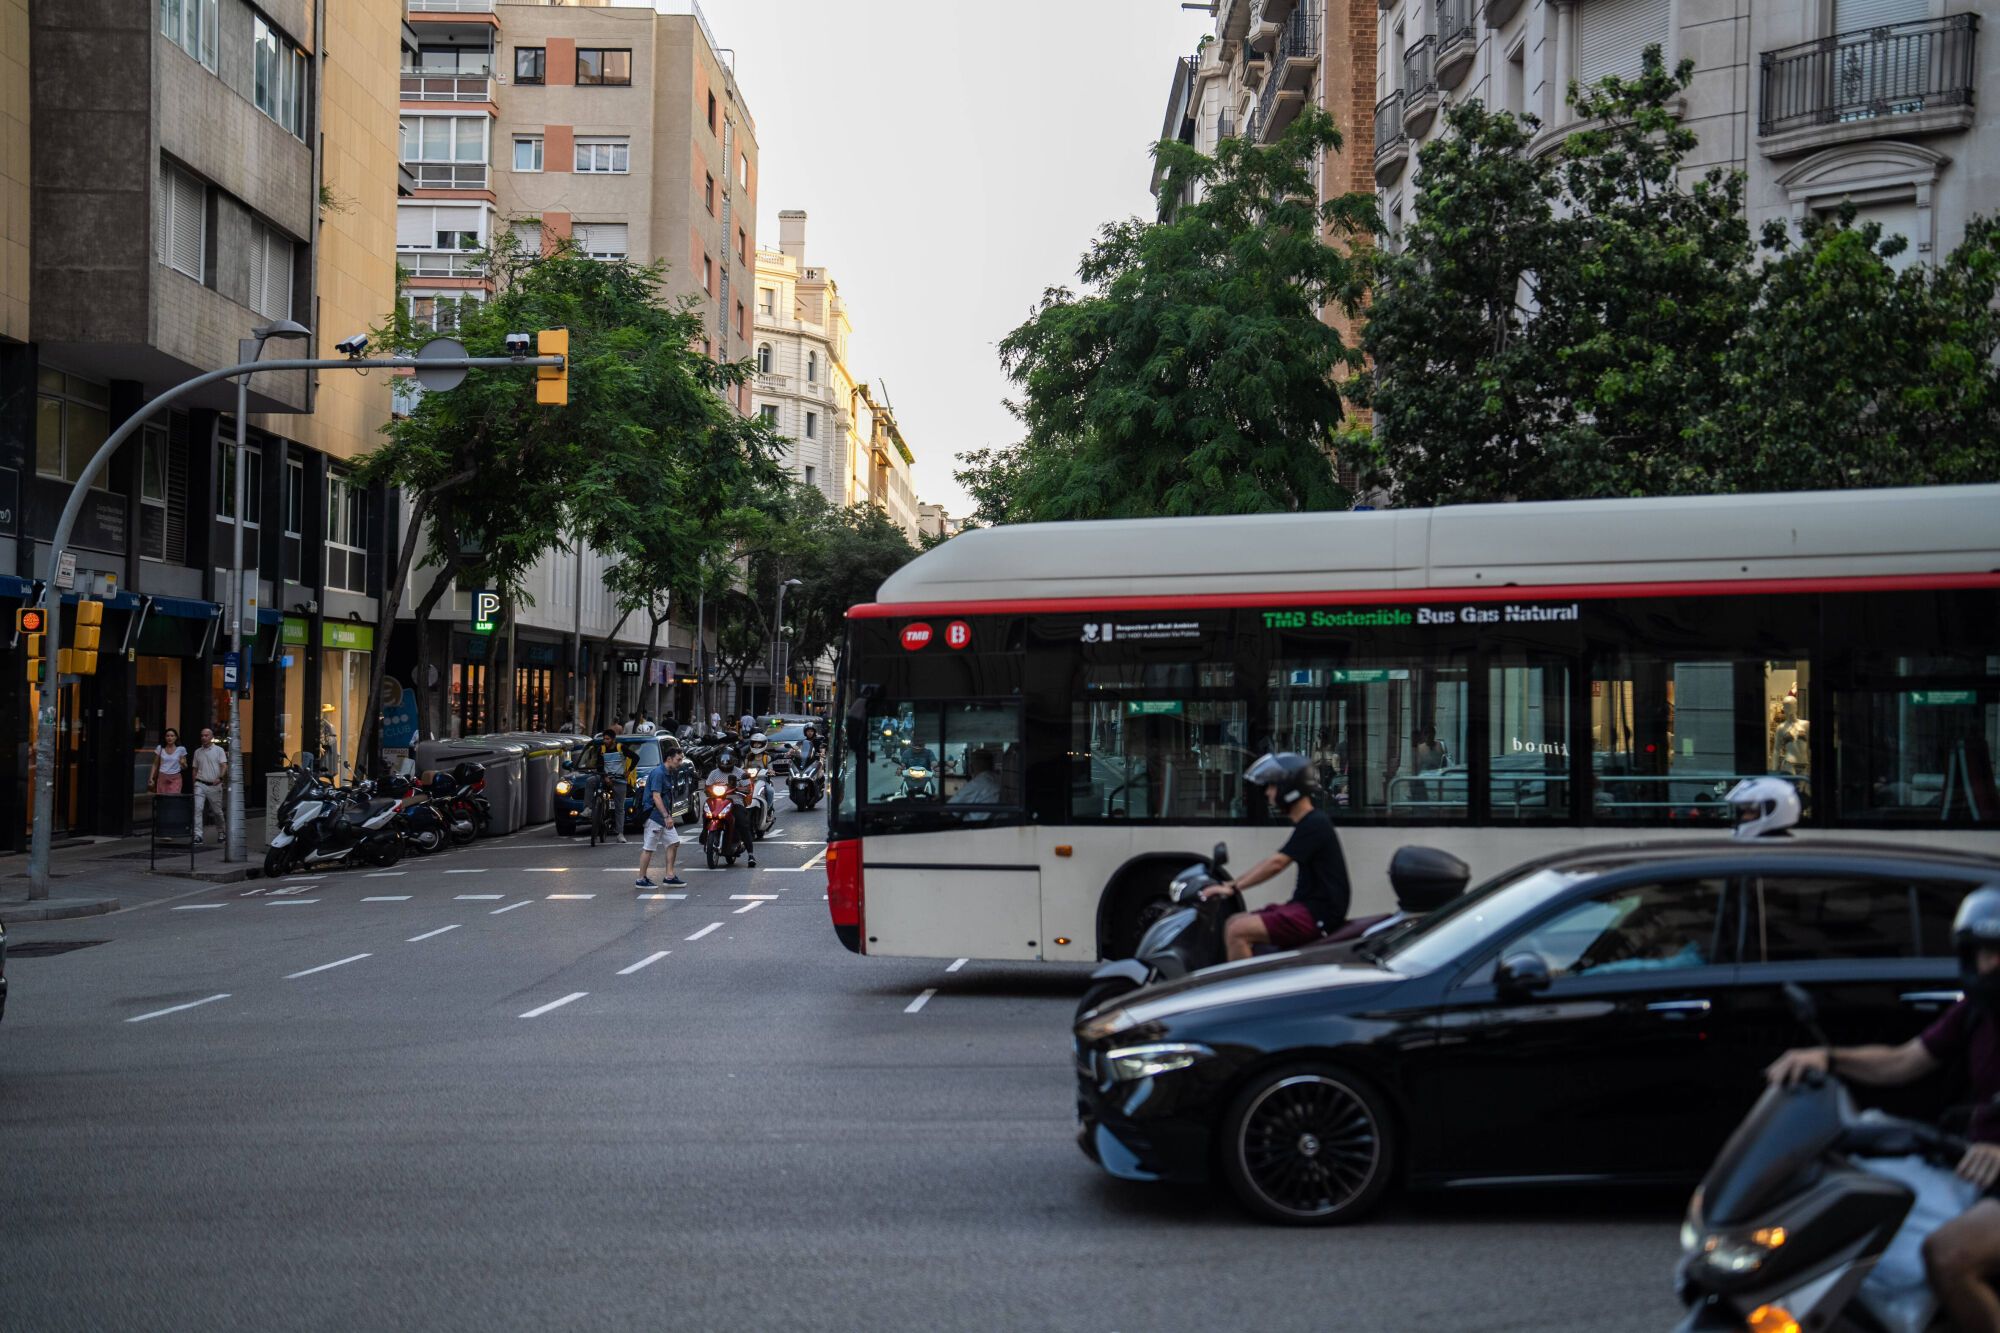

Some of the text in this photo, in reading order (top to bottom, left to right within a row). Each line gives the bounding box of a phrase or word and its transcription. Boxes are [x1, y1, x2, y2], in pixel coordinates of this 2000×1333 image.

[478, 593, 500, 621] P
[1262, 603, 1579, 629] TMB Sostenible Bus Gas Natural
[906, 630, 929, 641] TMB
[952, 625, 965, 644] B
[624, 661, 638, 672] m
[385, 725, 411, 737] CLUB
